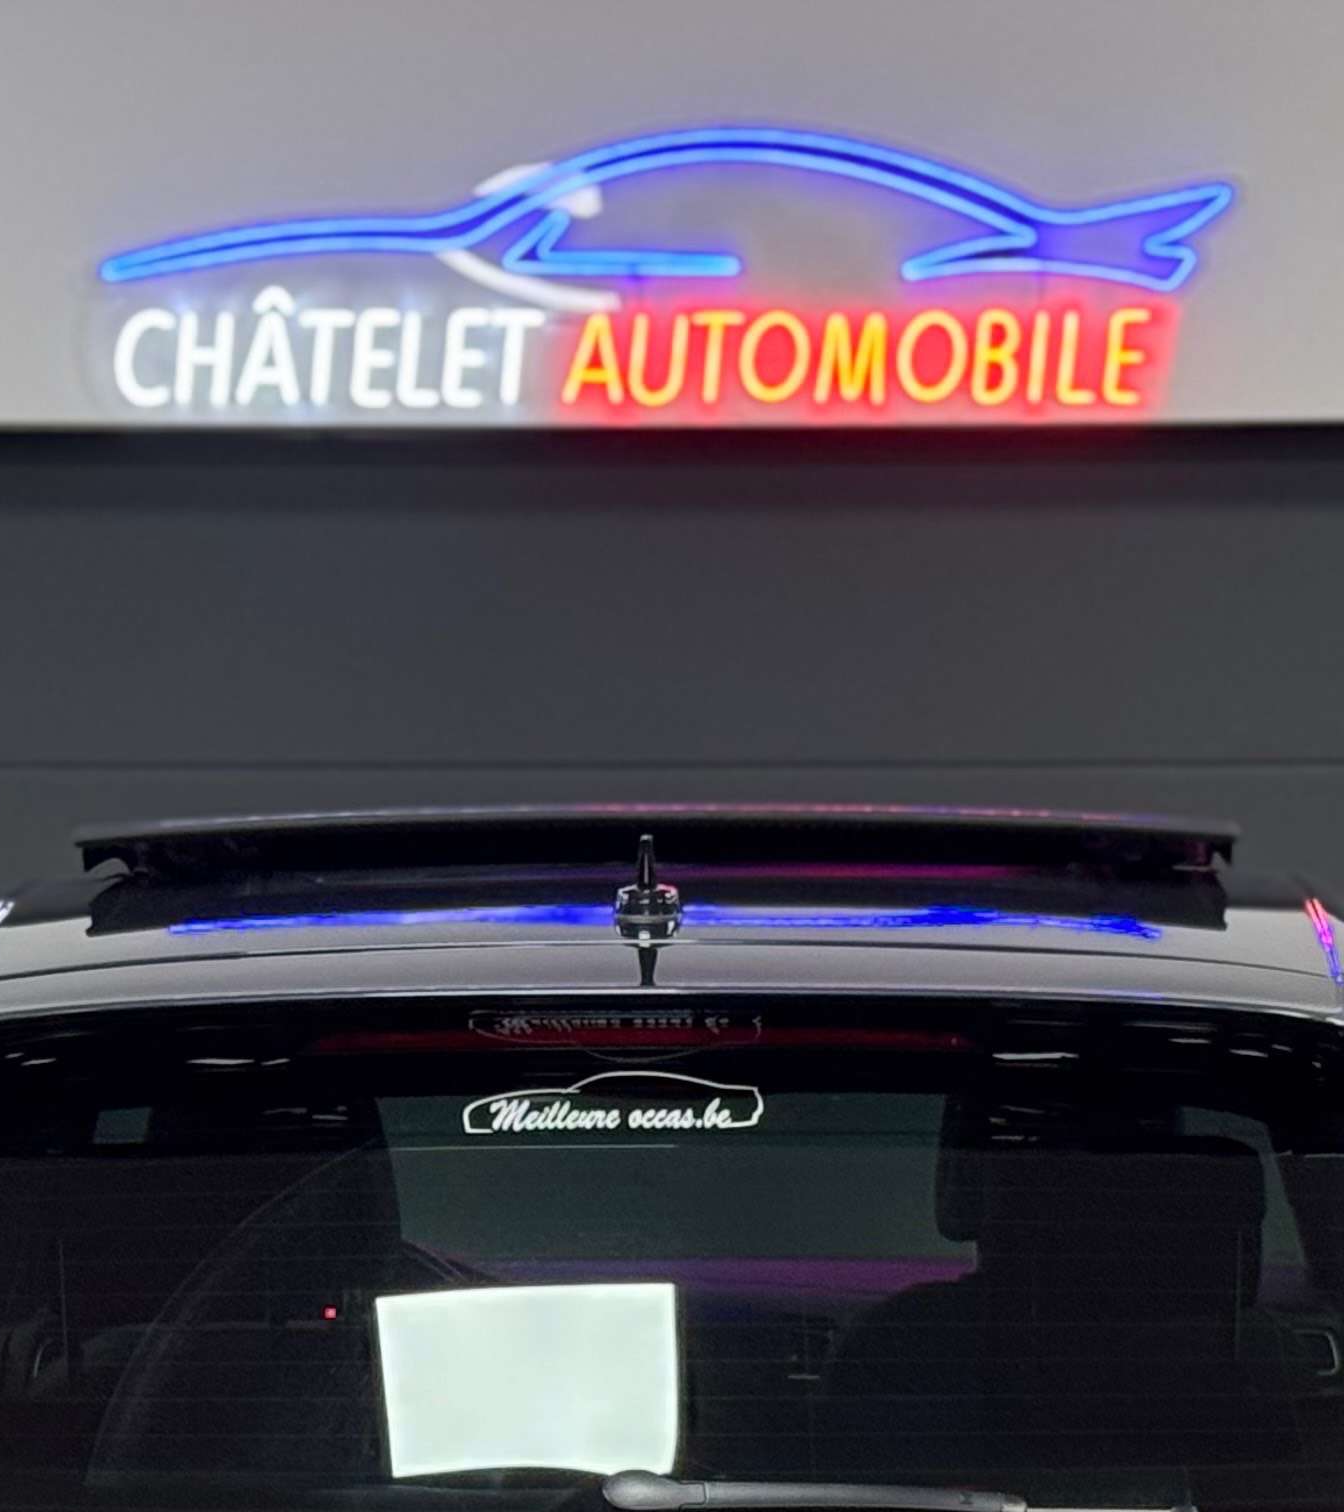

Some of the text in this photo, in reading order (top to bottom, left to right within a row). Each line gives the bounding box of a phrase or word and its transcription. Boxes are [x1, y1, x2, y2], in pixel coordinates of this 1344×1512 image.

[113, 286, 1152, 409] CHÂTELET AUTOMOBILE
[489, 1098, 732, 1132] Meilleure occas.be
